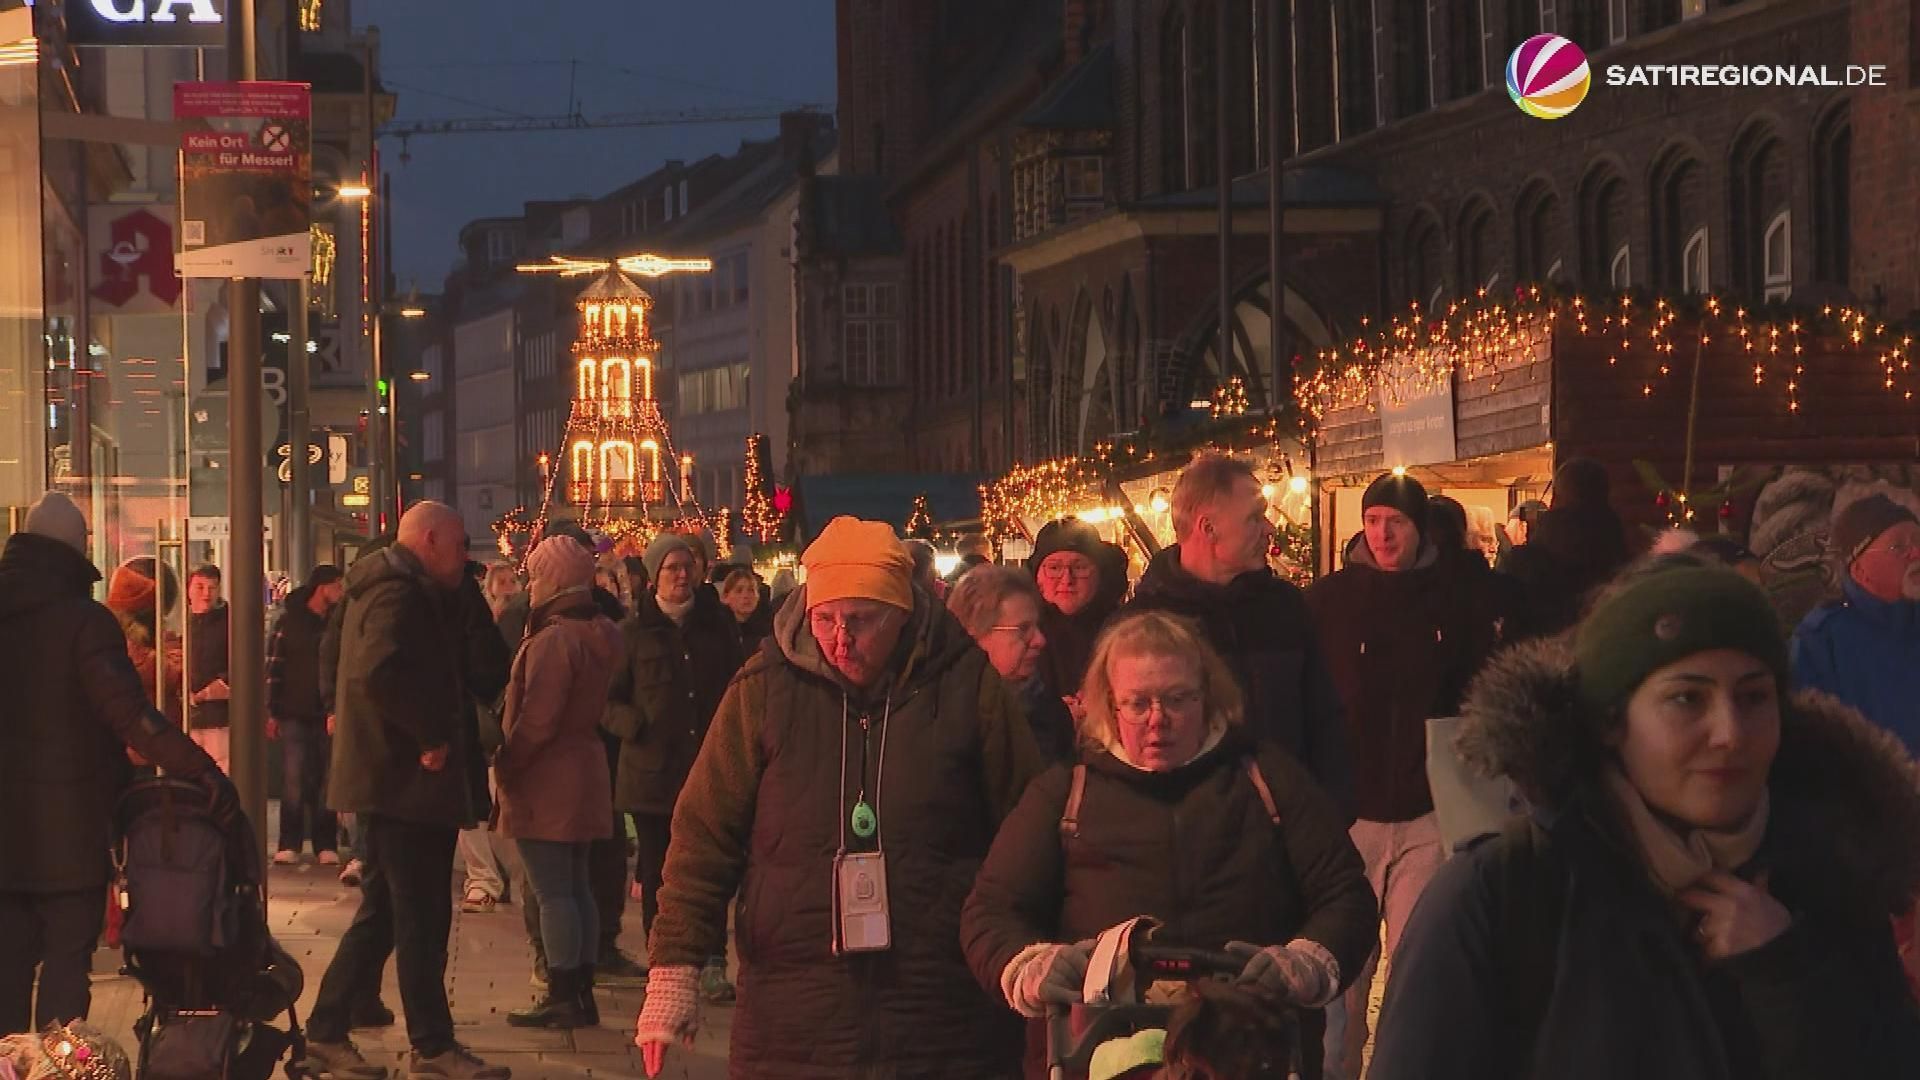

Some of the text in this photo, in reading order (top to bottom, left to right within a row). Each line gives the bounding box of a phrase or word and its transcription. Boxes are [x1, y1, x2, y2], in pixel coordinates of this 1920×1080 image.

[188, 136, 243, 148] Kein Ort
[219, 152, 293, 167] für Messer!
